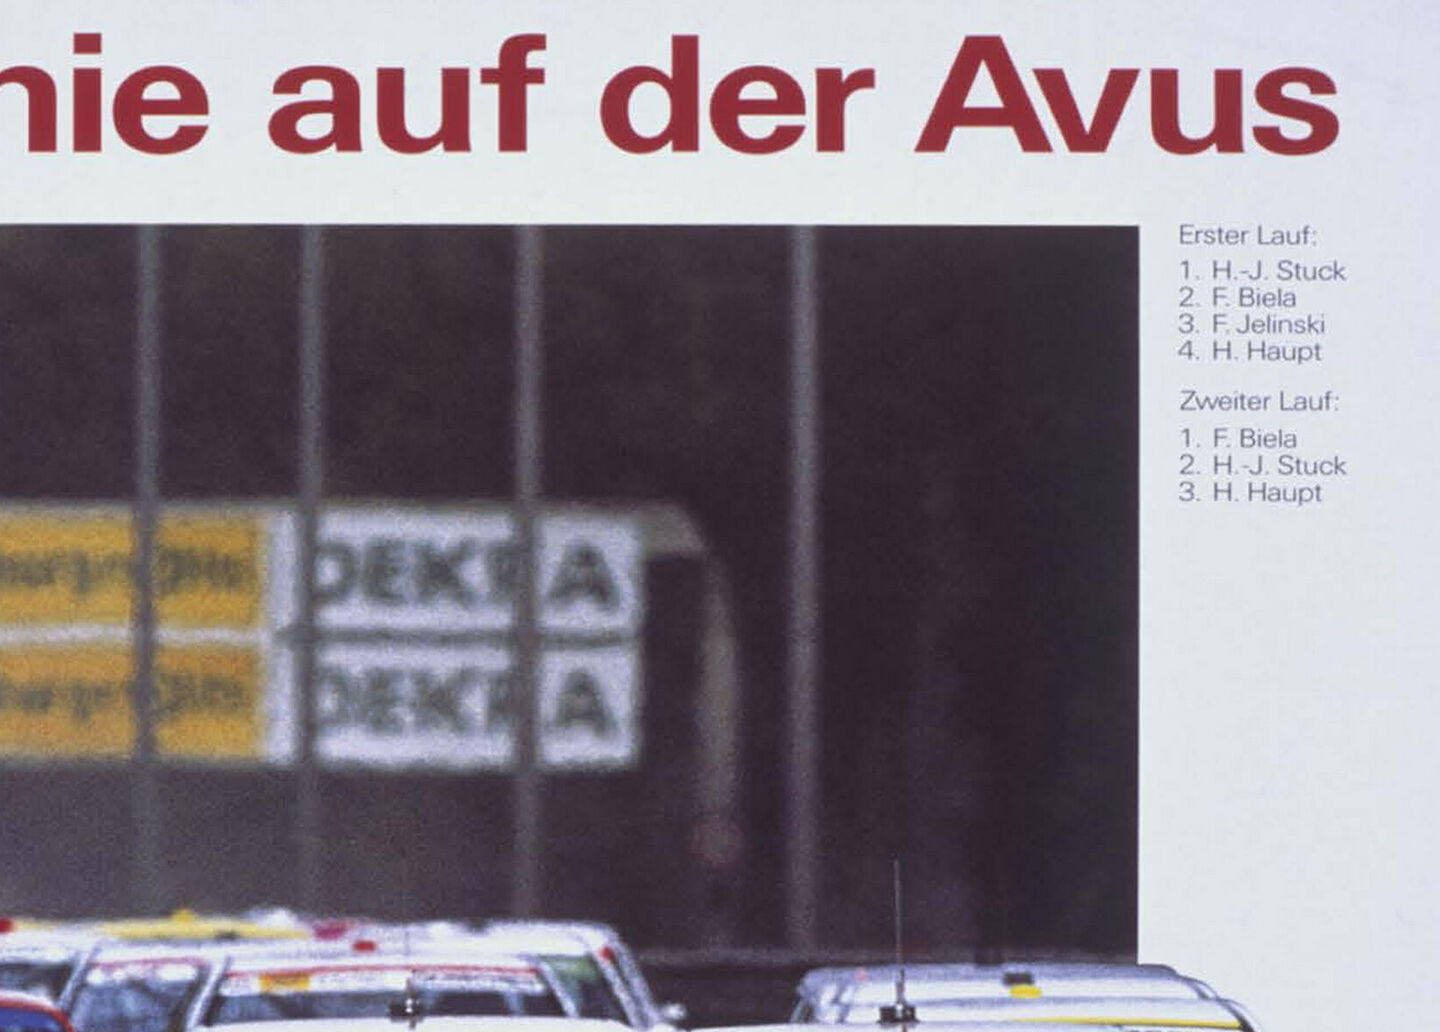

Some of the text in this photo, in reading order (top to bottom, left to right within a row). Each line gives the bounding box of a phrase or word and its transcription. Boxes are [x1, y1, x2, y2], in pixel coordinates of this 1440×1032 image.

[268, 33, 546, 154] auf
[600, 34, 875, 155] der
[914, 35, 1339, 156] Avus
[1180, 224, 1316, 245] Erster Lauf:
[1181, 260, 1346, 281] 1. H.-J. Stuck
[1179, 286, 1296, 308] 2. F. Biela
[1179, 313, 1324, 334] 3. F. Jelinski
[1178, 340, 1321, 365] 4. H. Haupt
[1180, 390, 1339, 411] Zweiter Lauf:
[1182, 428, 1297, 448] 1. F. Biela
[1180, 454, 1346, 475] 2. H.-J. Stuck
[1179, 481, 1321, 506] 3. H. Haupt
